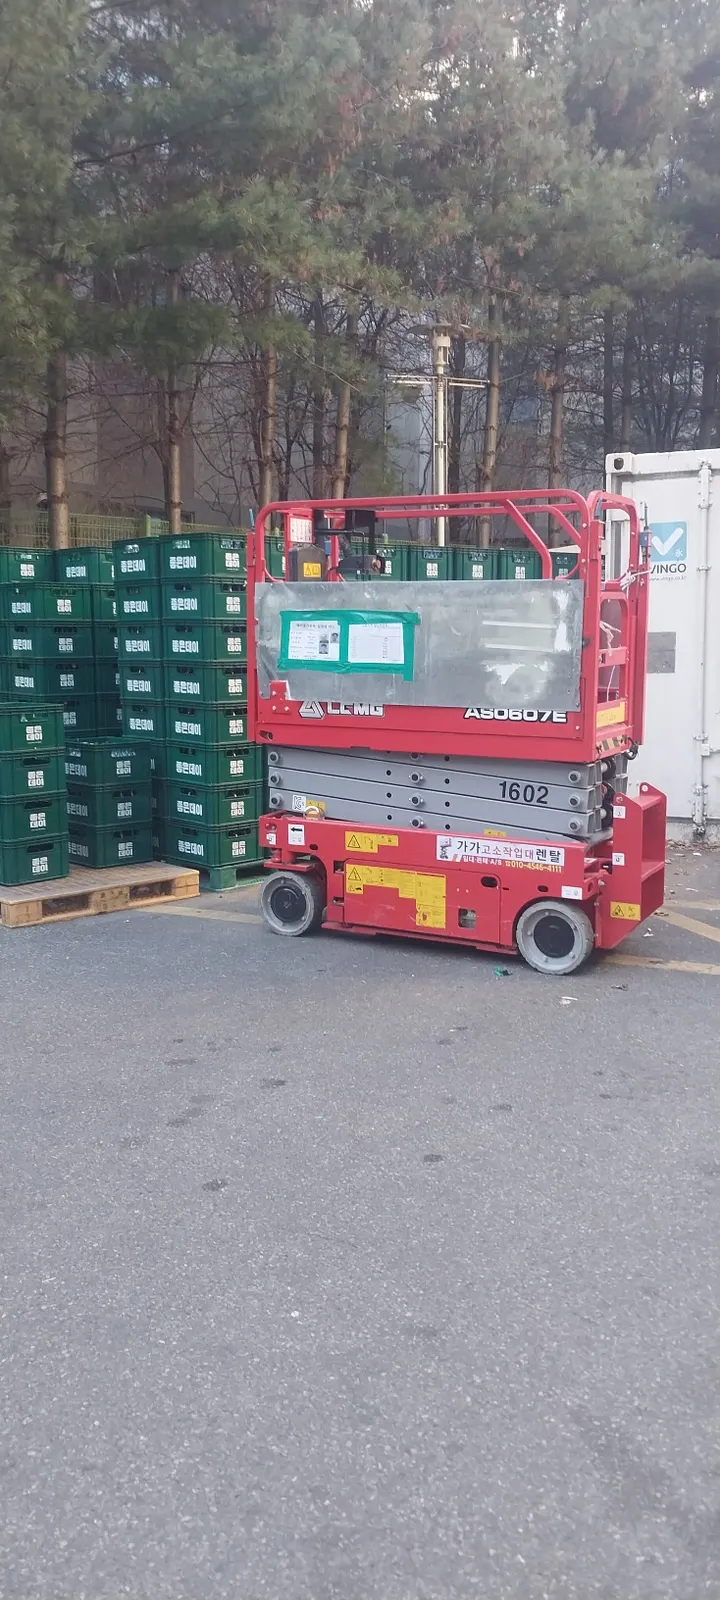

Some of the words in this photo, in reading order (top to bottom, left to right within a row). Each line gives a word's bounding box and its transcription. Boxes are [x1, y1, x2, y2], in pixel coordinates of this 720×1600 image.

[121, 559, 145, 572] 좋은데이
[170, 556, 196, 569] 좋은데이
[124, 601, 148, 613] 좋은데이
[171, 598, 197, 611] 좋은데이
[226, 604, 240, 612] 데이
[126, 640, 150, 652] 좋은데이
[172, 640, 198, 653] 좋은데이
[227, 644, 241, 652] 데이
[127, 680, 151, 692] 좋은데이
[174, 681, 200, 694] 좋은데이
[228, 685, 242, 693] 데이
[130, 717, 153, 731] 좋은데이
[175, 721, 201, 735] 좋은데이
[229, 726, 243, 734] 데이
[26, 733, 42, 741] 데이
[176, 761, 202, 776] 좋은데이
[28, 778, 44, 787] 데이
[499, 781, 549, 805] 1602
[177, 800, 203, 816] 좋은데이
[231, 808, 244, 816] 데이
[30, 820, 46, 828] 데이
[178, 840, 204, 856] 좋은데이
[232, 848, 245, 856] 데이
[32, 864, 48, 873] 데이
